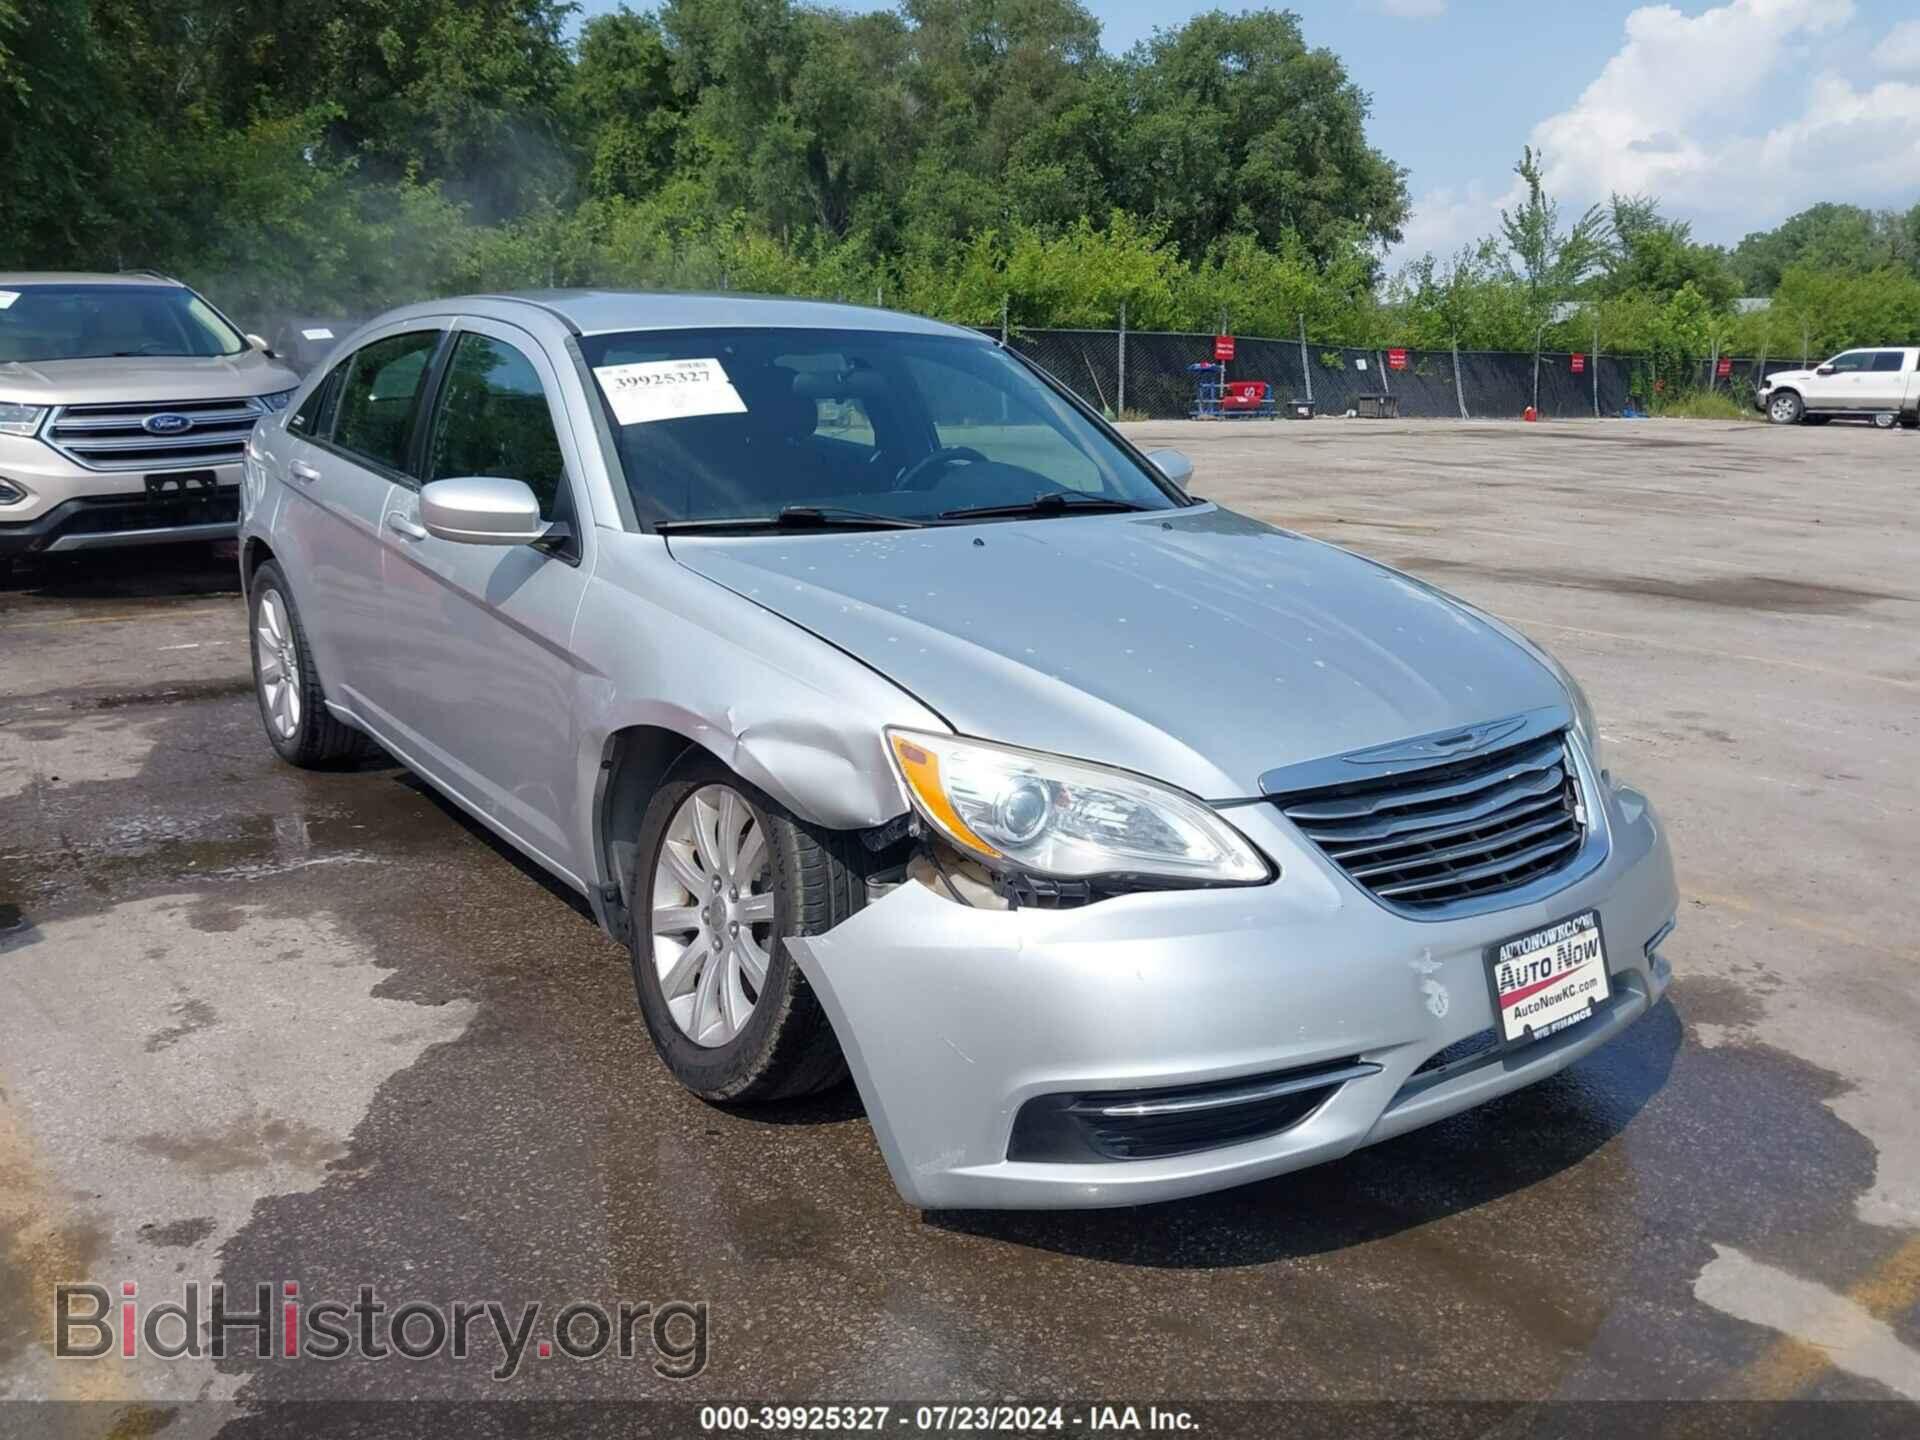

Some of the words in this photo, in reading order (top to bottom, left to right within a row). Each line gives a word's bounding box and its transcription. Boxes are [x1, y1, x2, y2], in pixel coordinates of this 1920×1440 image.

[614, 371, 710, 389] 39925327
[1514, 977, 1598, 1020] AutoNowKC.com
[1551, 1008, 1593, 1034] FINANCE
